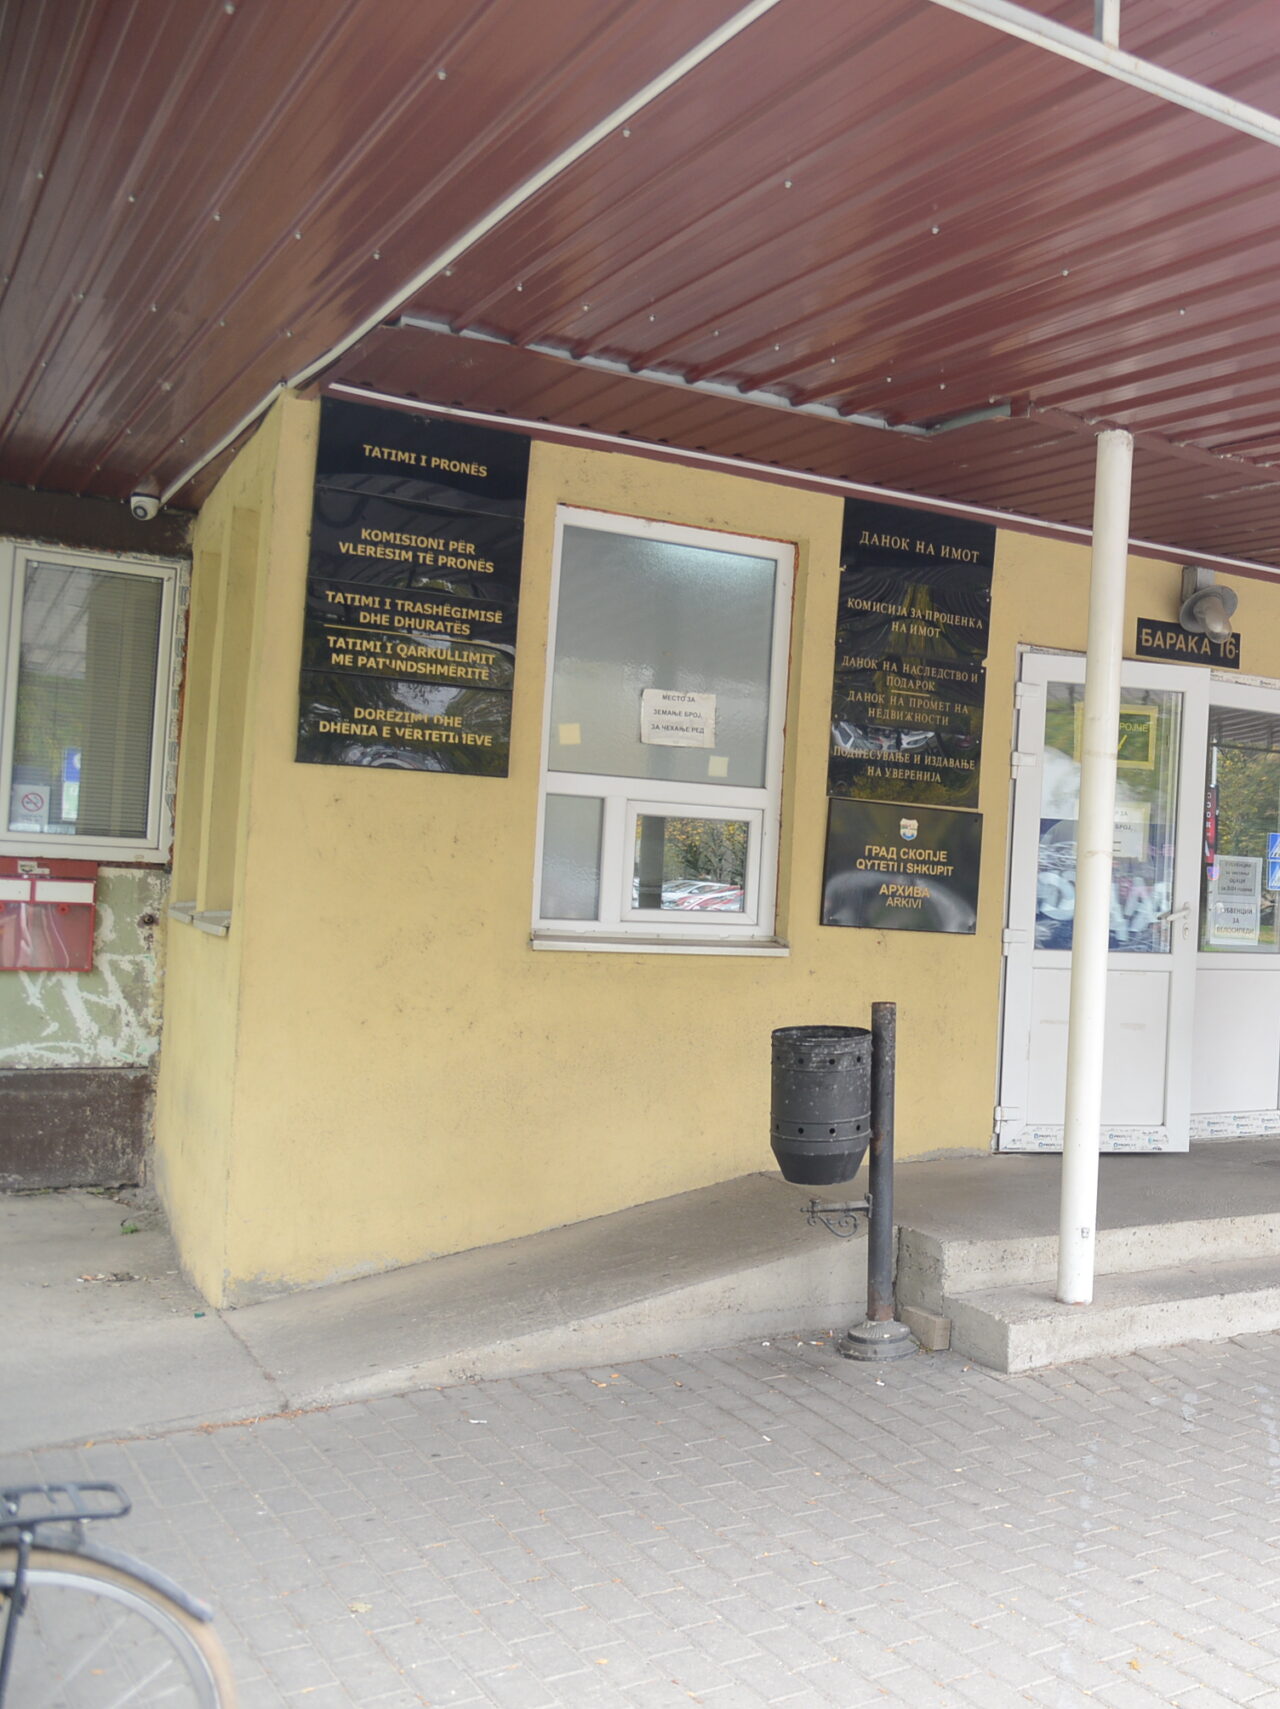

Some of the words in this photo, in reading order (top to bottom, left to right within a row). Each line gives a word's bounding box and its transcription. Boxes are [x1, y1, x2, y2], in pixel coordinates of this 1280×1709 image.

[363, 444, 416, 465] TATIMI
[420, 455, 427, 467] I
[431, 457, 488, 477] PRONËS
[361, 528, 445, 551] KOMISIONI
[449, 538, 475, 555] PËR
[859, 531, 910, 551] ДАНОК
[916, 540, 935, 556] НА
[940, 545, 980, 563] ИМОТ
[338, 541, 413, 562] VLERËSIM
[417, 551, 434, 565] TË
[438, 555, 494, 574] PRONËS
[325, 591, 380, 609] TATIMI
[384, 598, 391, 610] I
[395, 599, 503, 624] TRASHËGIMISË
[847, 597, 908, 617] КОМИСИЈА
[910, 608, 922, 619] ЗА
[925, 609, 983, 629] ПРОЦЕНКА
[359, 612, 390, 626] DHE
[394, 614, 470, 635] DHURATËS
[891, 621, 907, 633] НА
[910, 624, 941, 639] ИМОТ
[327, 635, 381, 653] TATIMI
[386, 642, 393, 654] I
[396, 643, 495, 665] QARKULLIMIT
[1141, 628, 1211, 656] БАРАКА
[1219, 637, 1236, 659] 16
[331, 653, 353, 667] ME
[358, 656, 489, 680] PATUNDSHMËRITË
[841, 655, 878, 669] ДАНОК
[883, 662, 898, 672] НА
[902, 663, 968, 681] НАСЛЕДСТВО
[971, 673, 978, 683] И
[886, 676, 936, 692] ПОДАРОК
[662, 694, 686, 702] МЕСТО
[847, 690, 885, 704] ДАНОК
[890, 696, 905, 707] НА
[909, 698, 951, 712] ПРОМЕТ
[954, 704, 969, 715] НА
[434, 714, 462, 728] DHE
[868, 707, 949, 726] НЕДВИЖНОСТИ
[319, 718, 378, 737] DHËNIA
[382, 726, 391, 738] E
[1119, 722, 1149, 732] РОЈЧЕ
[913, 754, 921, 763] И
[924, 755, 975, 770] ИЗДАВАЊЕ
[867, 766, 882, 777] НА
[885, 767, 942, 783] УВЕРЕНИЈА
[864, 845, 897, 860] ГРАД
[900, 848, 948, 862] СКОПЈЕ
[856, 859, 897, 873] QYTETI
[900, 863, 904, 873] I
[906, 863, 954, 877] SHKUPIT
[879, 884, 930, 898] АРХИВА
[886, 897, 922, 909] ARKIVI
